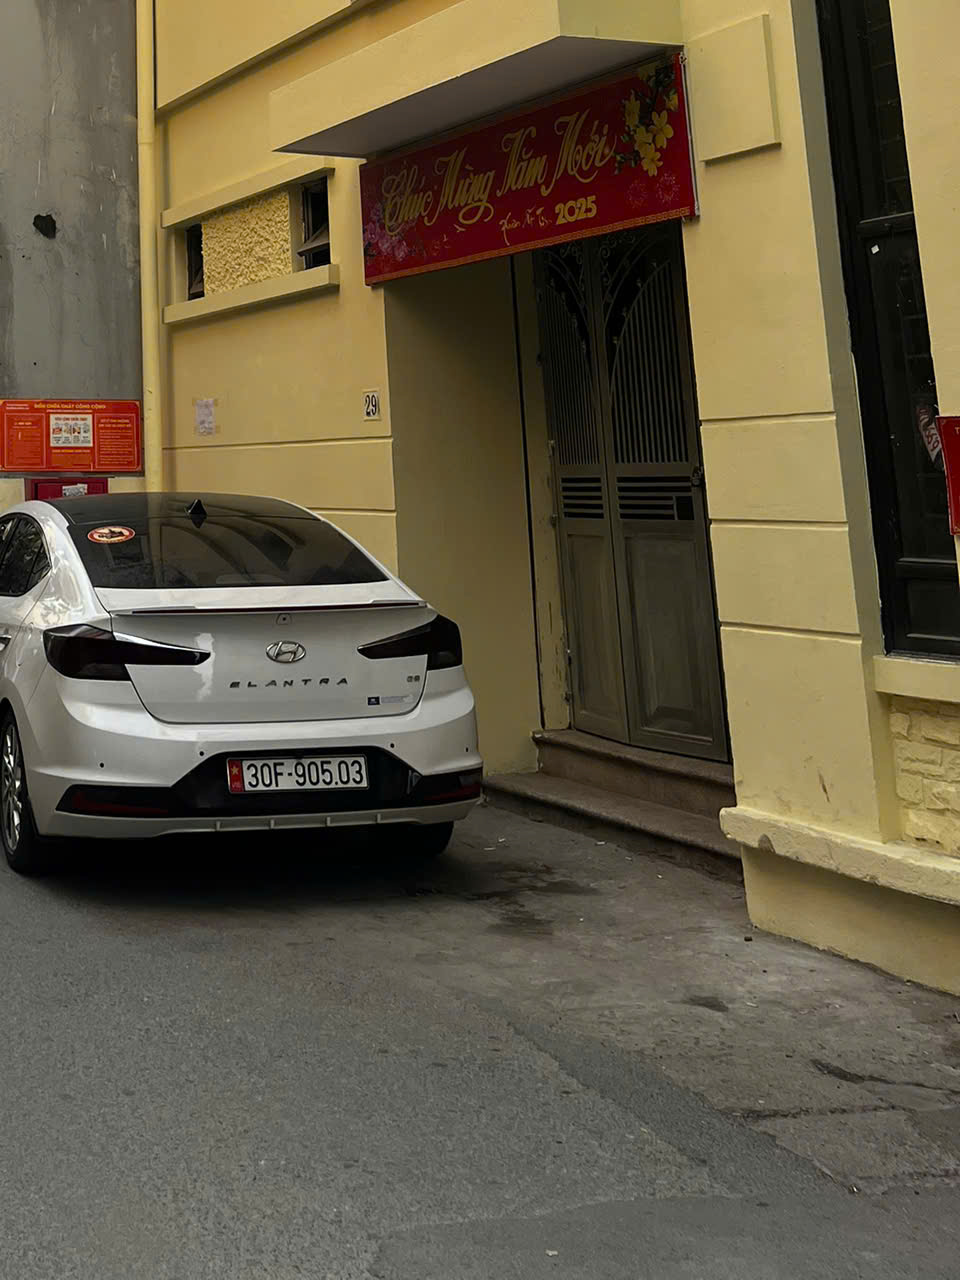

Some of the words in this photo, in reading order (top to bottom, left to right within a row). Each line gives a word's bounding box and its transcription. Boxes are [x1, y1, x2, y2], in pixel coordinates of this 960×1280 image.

[382, 160, 432, 236] Chúc
[424, 144, 496, 226] Mừng
[496, 127, 548, 197] Năm
[540, 108, 618, 197] Mới
[555, 195, 597, 225] 2025
[364, 394, 378, 417] 29
[229, 677, 349, 689] ELANTRA
[247, 759, 364, 789] 30F-905.03
